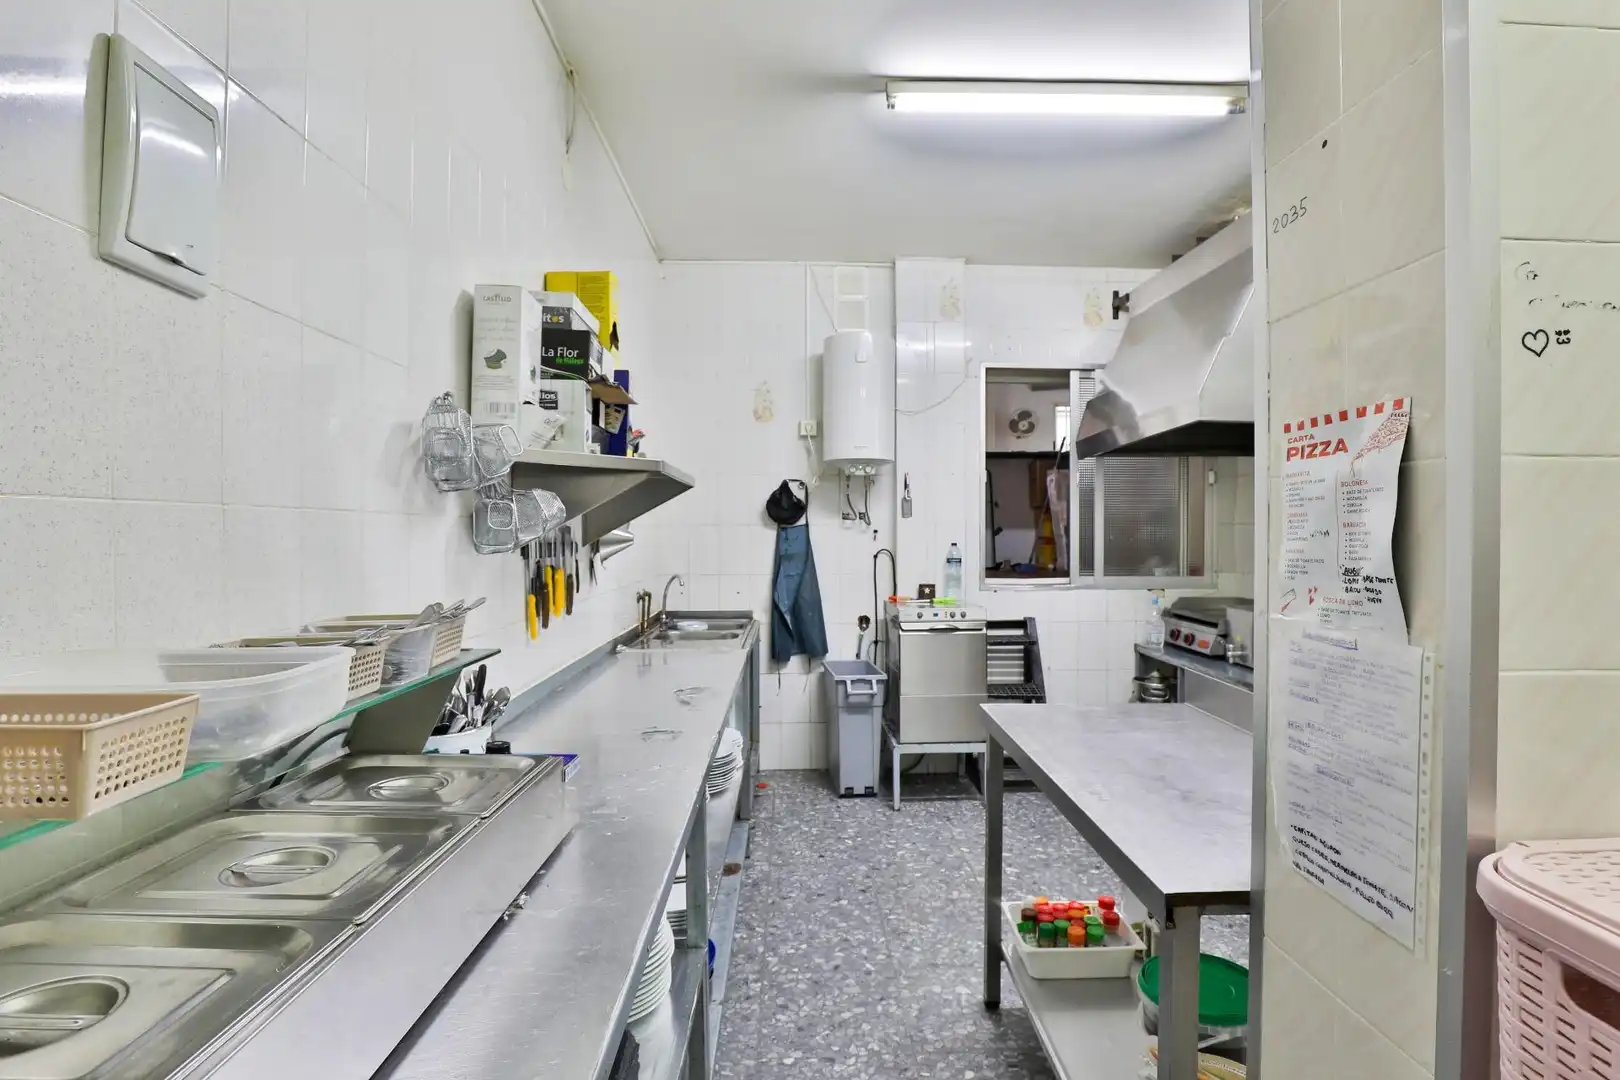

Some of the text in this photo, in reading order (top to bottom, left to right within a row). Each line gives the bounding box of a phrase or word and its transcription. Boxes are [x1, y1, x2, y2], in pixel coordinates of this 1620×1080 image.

[1272, 196, 1308, 234] 2035
[542, 346, 580, 359] La Flor
[1287, 433, 1315, 445] CARTA
[1286, 438, 1349, 461] PIZZA
